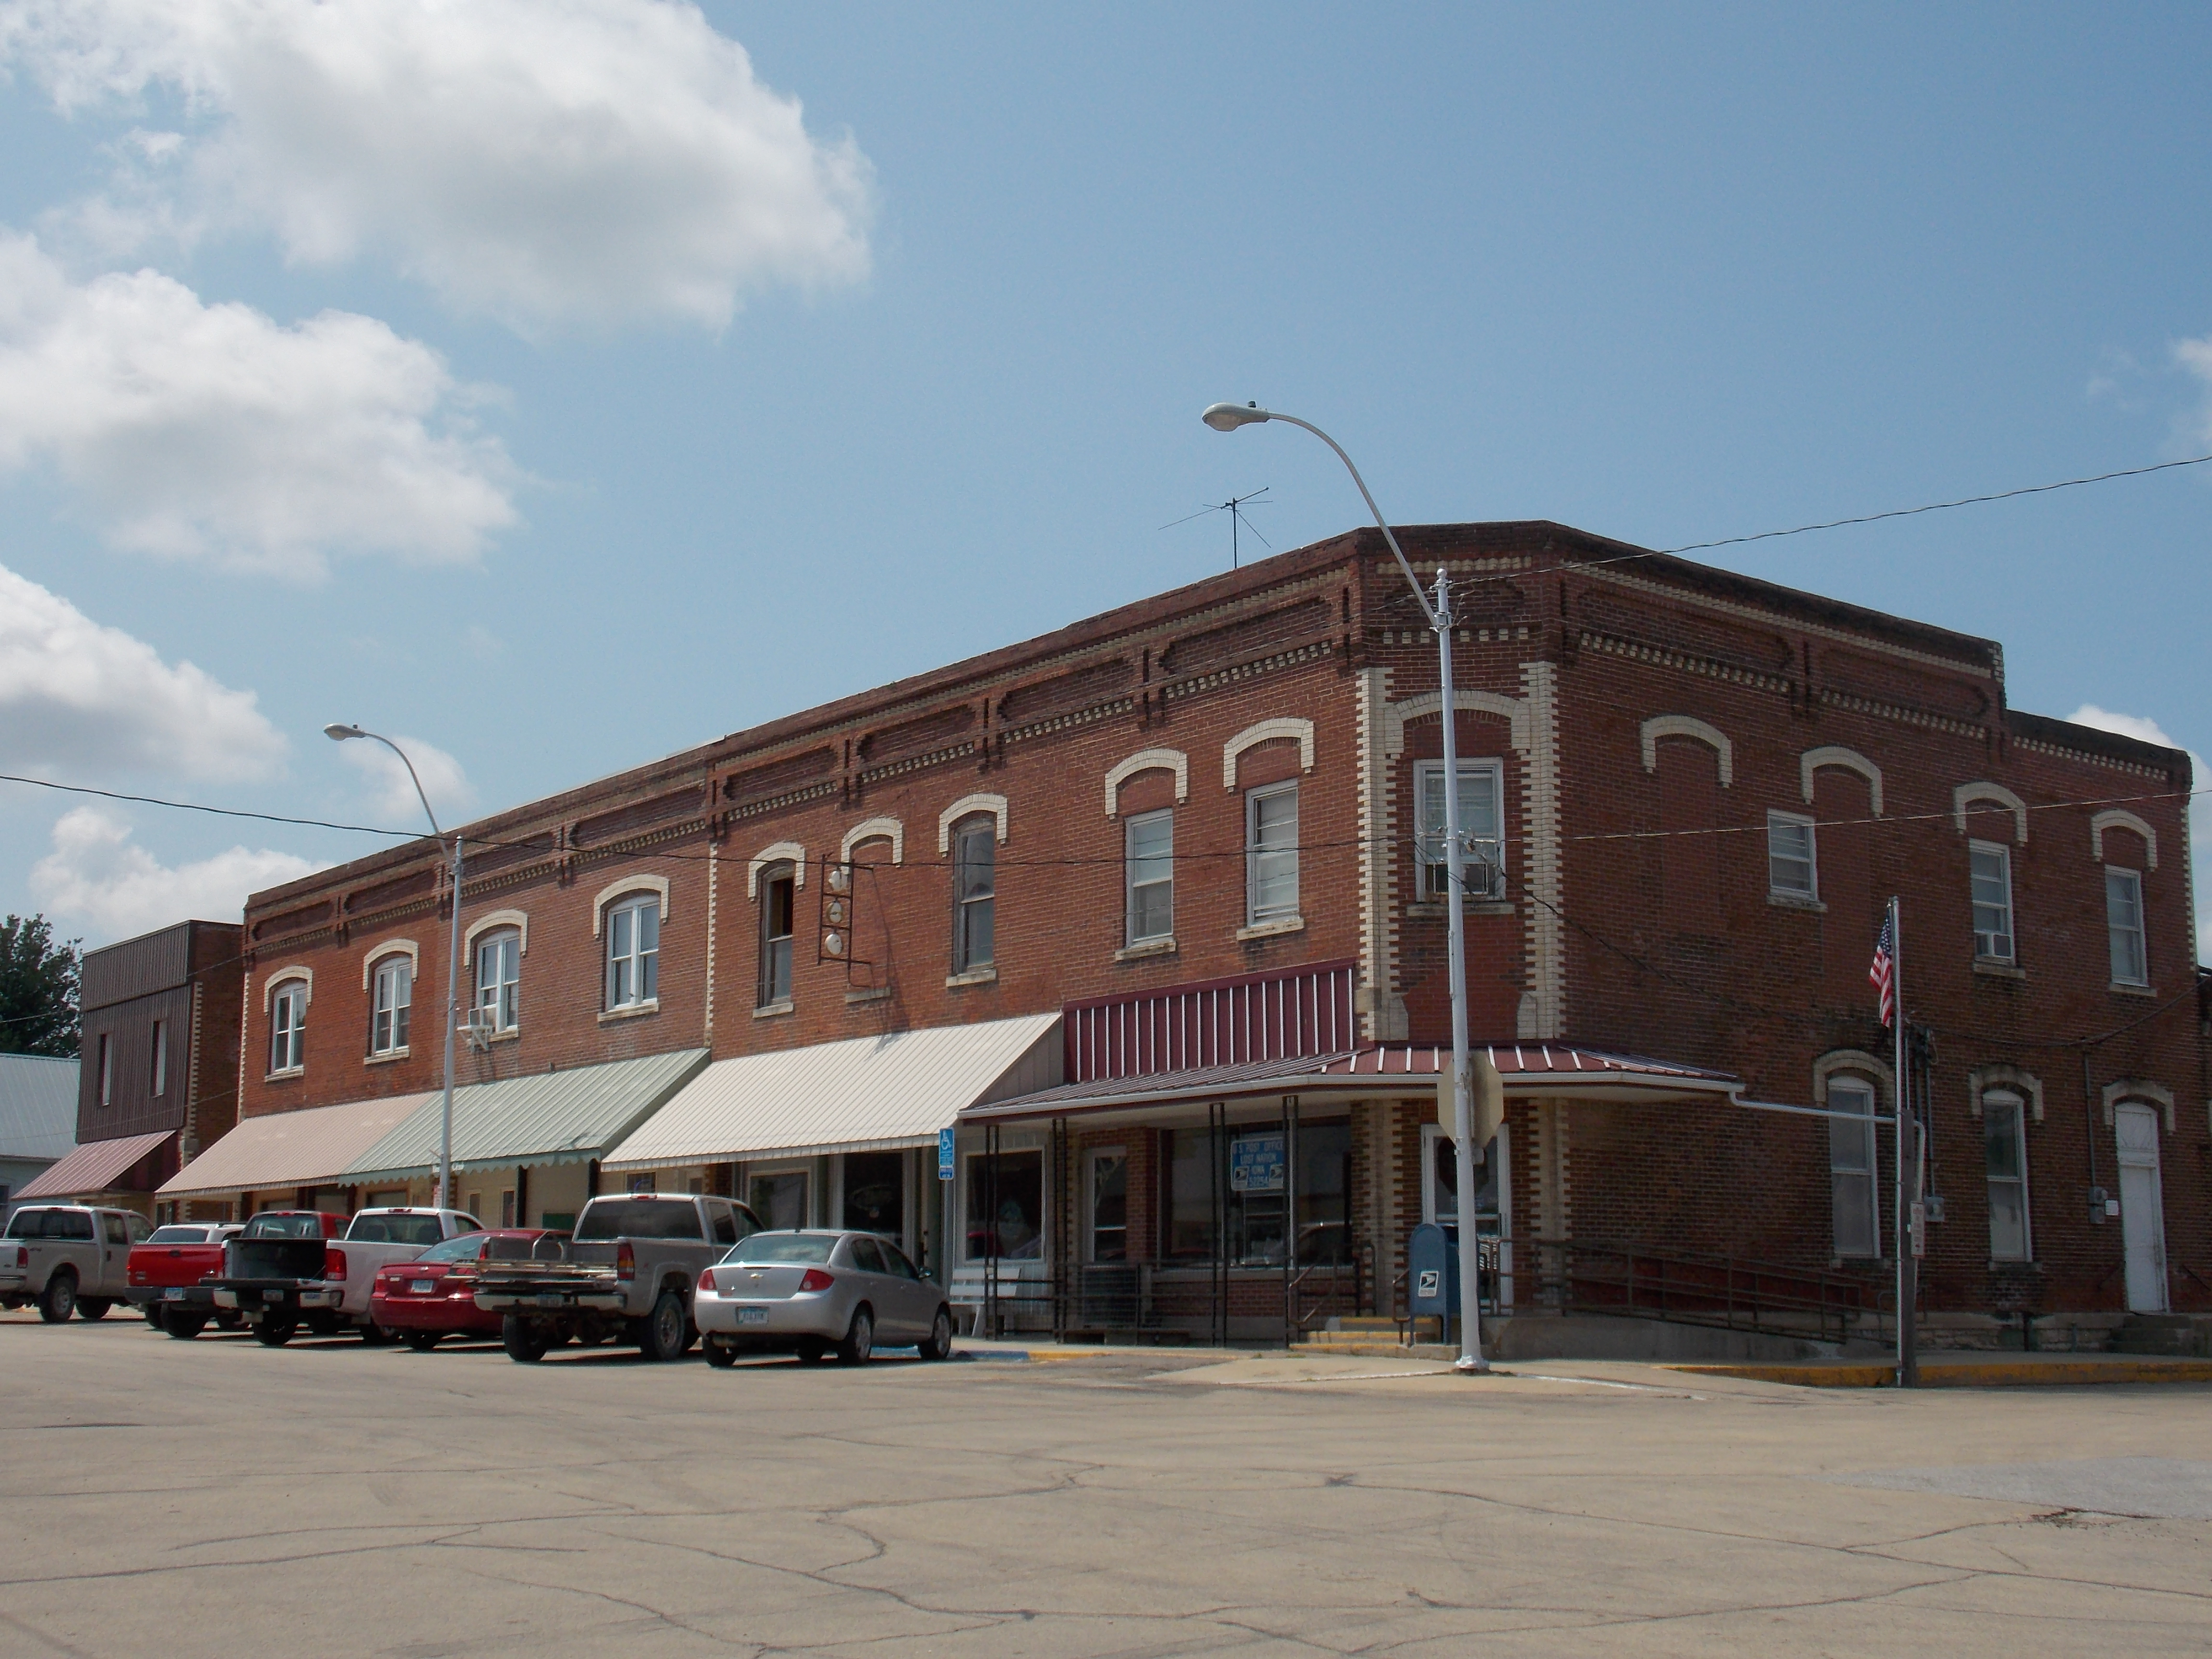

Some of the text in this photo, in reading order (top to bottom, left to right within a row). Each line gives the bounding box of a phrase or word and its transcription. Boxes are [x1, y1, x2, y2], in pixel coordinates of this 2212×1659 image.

[1245, 1142, 1260, 1153] POST
[1240, 1152, 1277, 1165] LOST NATION
[1250, 1165, 1265, 1175] IOWA
